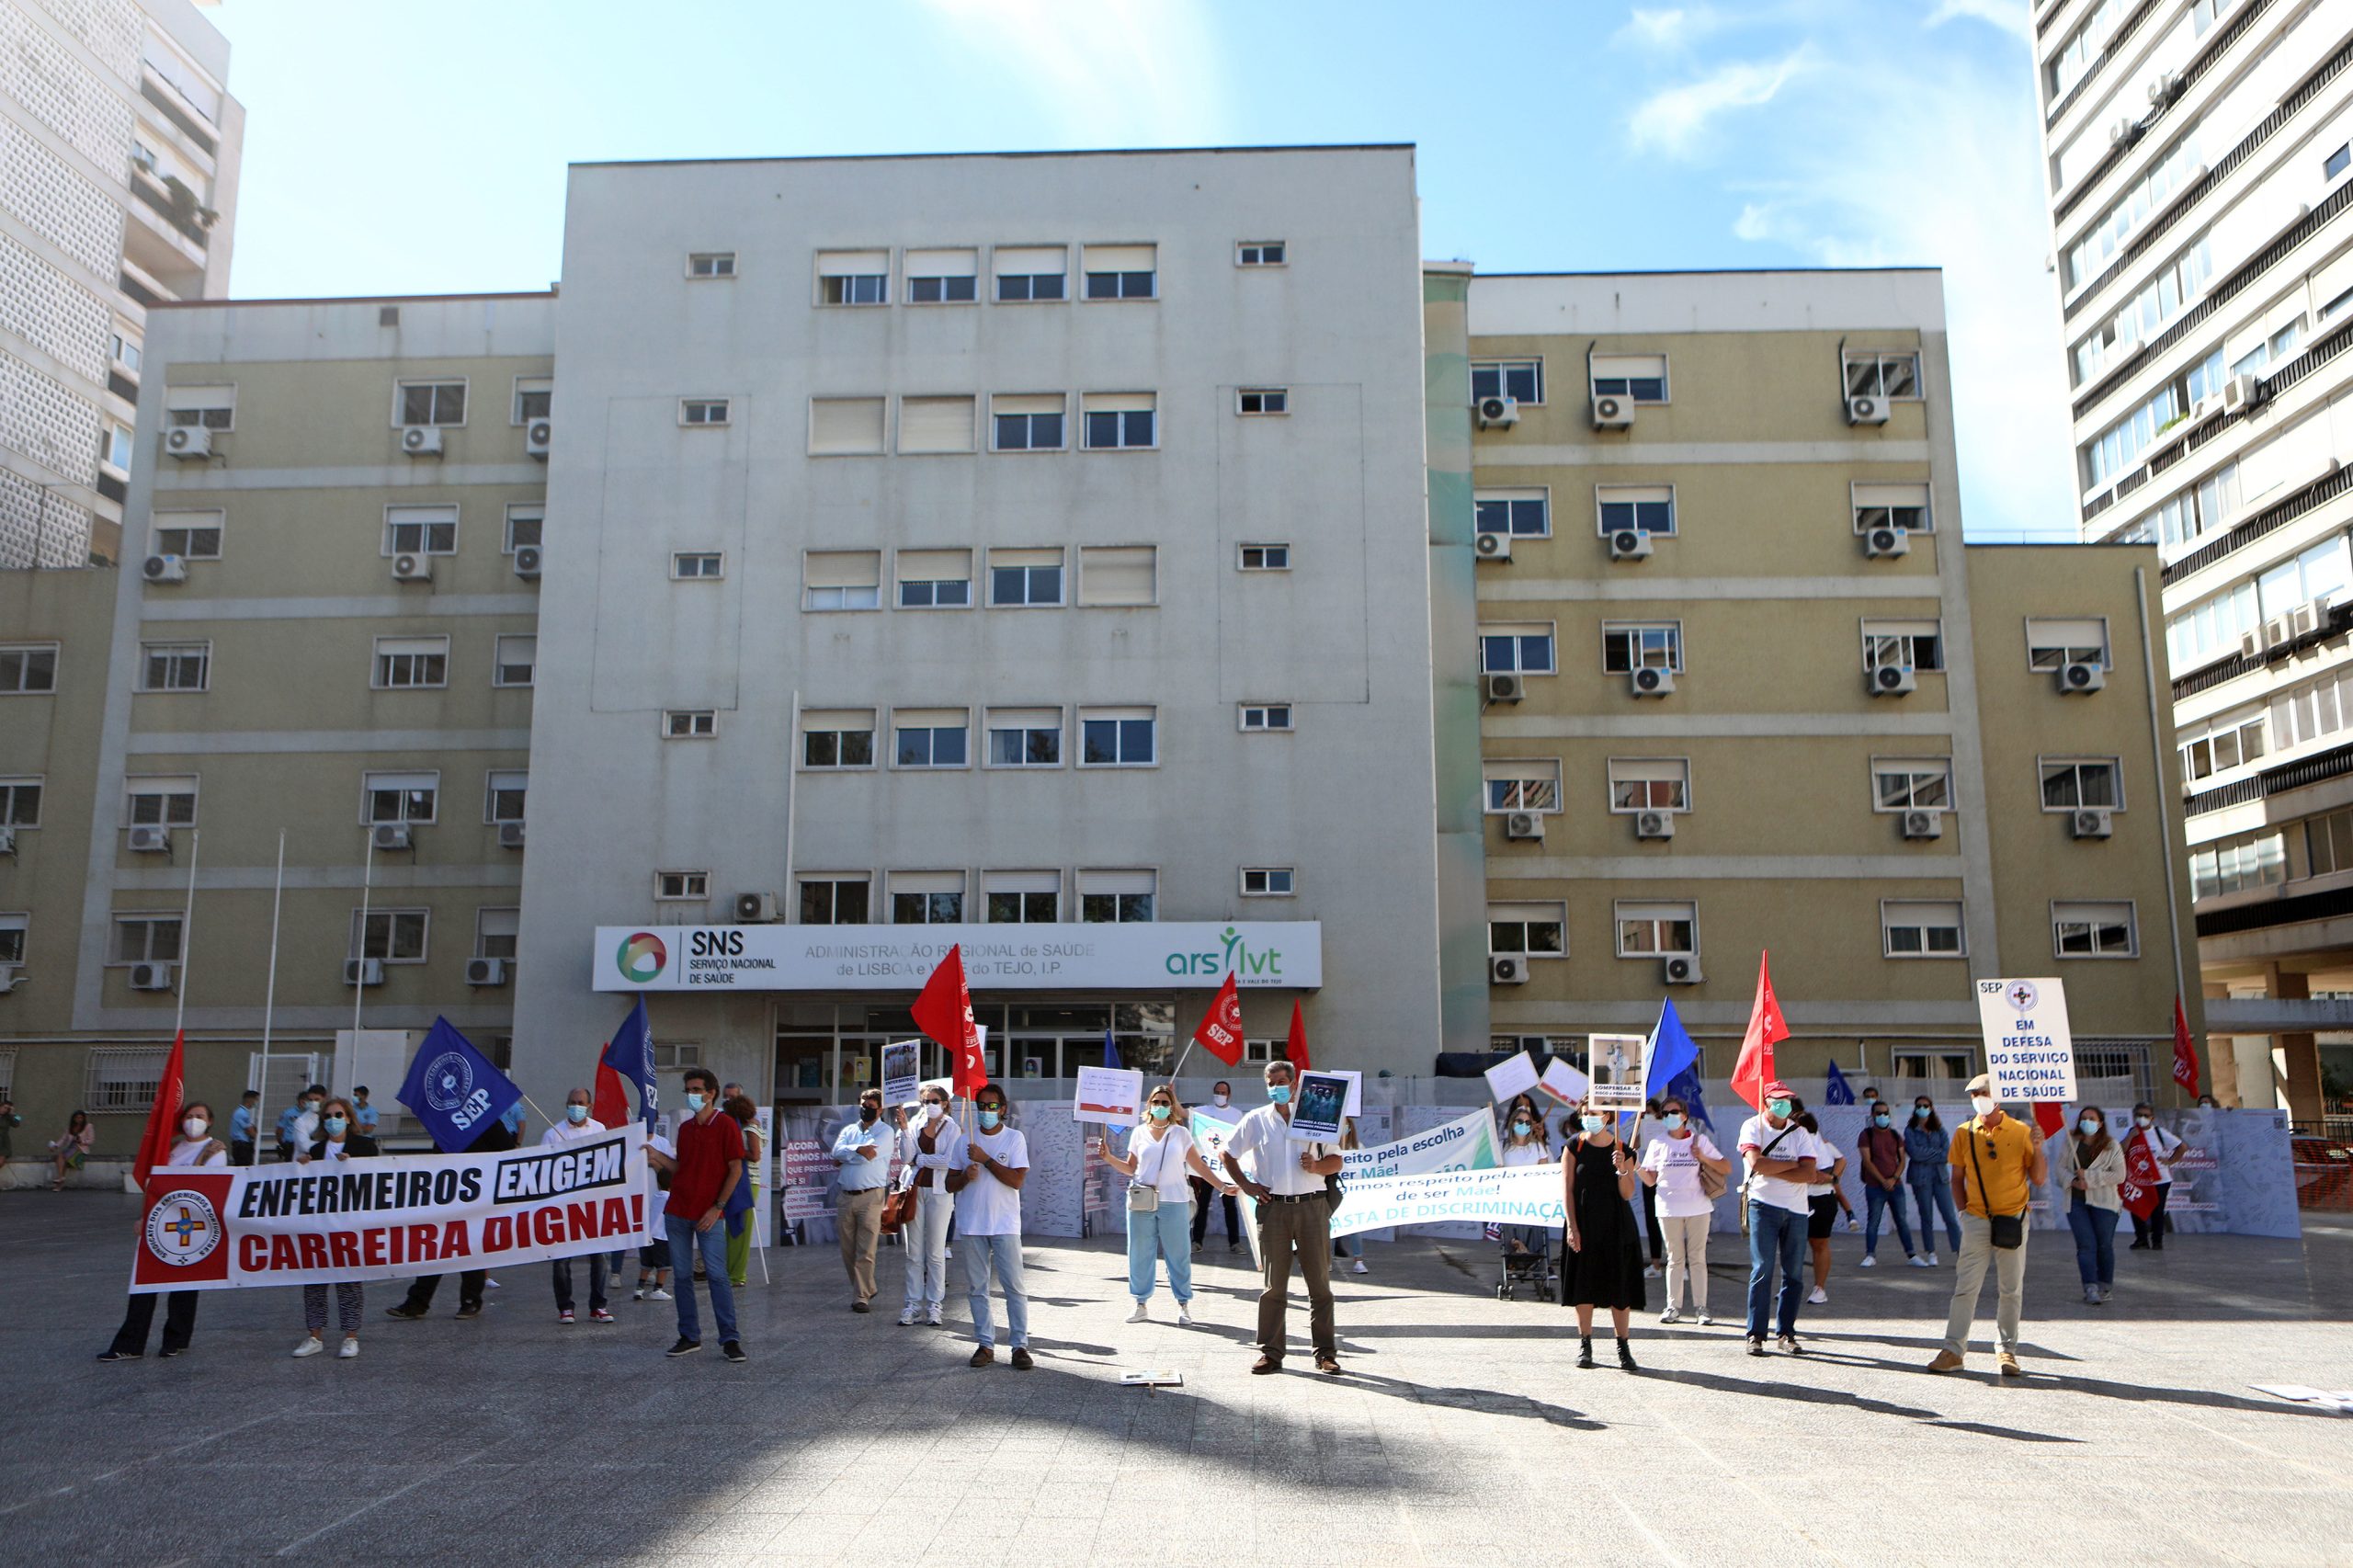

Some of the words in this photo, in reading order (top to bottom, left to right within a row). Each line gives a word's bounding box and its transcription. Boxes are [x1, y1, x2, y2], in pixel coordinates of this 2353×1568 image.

[691, 930, 744, 956] SNS
[805, 943, 932, 959] ADMINISTRAÇÃO
[1020, 943, 1038, 957] de
[1042, 942, 1095, 957] SAÚDE
[689, 959, 728, 971] SERVIÇO
[731, 959, 776, 969] NACIONAL
[836, 963, 853, 975] de
[858, 962, 914, 975] LISBOA
[916, 964, 926, 975] e
[972, 962, 989, 974] do
[994, 961, 1037, 976] TEJO,
[689, 973, 701, 983] DE
[704, 971, 734, 983] SAÚDE
[1980, 983, 2003, 994] SEP
[2016, 1019, 2034, 1030] EM
[1206, 1022, 1234, 1047] SEP
[2003, 1036, 2052, 1048] DEFESA
[1990, 1054, 2008, 1064] DO
[2012, 1052, 2068, 1066] SERVIÇO
[1998, 1069, 2065, 1081] NACIONAL
[2001, 1086, 2018, 1098] DE
[2022, 1083, 2066, 1097] SAÚDE
[450, 1088, 492, 1131] SEP
[787, 1141, 821, 1151] AGORA
[1344, 1153, 1372, 1164] eito
[1378, 1144, 1408, 1164] pela
[1413, 1123, 1464, 1152] escolha
[787, 1153, 820, 1163] SOMOS
[787, 1165, 802, 1175] QUE
[1361, 1164, 1398, 1179] Mãe!
[238, 1167, 483, 1218] ENFERMEIROS
[497, 1143, 621, 1199] EXIGEM
[1339, 1182, 1392, 1195] gimos
[1399, 1174, 1472, 1187] respeito
[1479, 1171, 1517, 1183] pela
[162, 1192, 209, 1209] ENFERMEIROS
[1396, 1191, 1417, 1201] de
[1424, 1190, 1449, 1199] ser
[1456, 1185, 1500, 1197] Mãe!
[150, 1207, 163, 1222] DOS
[1331, 1210, 1379, 1230] ASTA
[1387, 1205, 1412, 1220] DE
[1416, 1199, 1566, 1222] DISCRIMINAÇÃ
[199, 1208, 221, 1256] PORTUGUESES
[239, 1221, 471, 1273] CARREIRA
[483, 1194, 643, 1254] DIGNA!
[147, 1223, 168, 1258] SINDICATO
